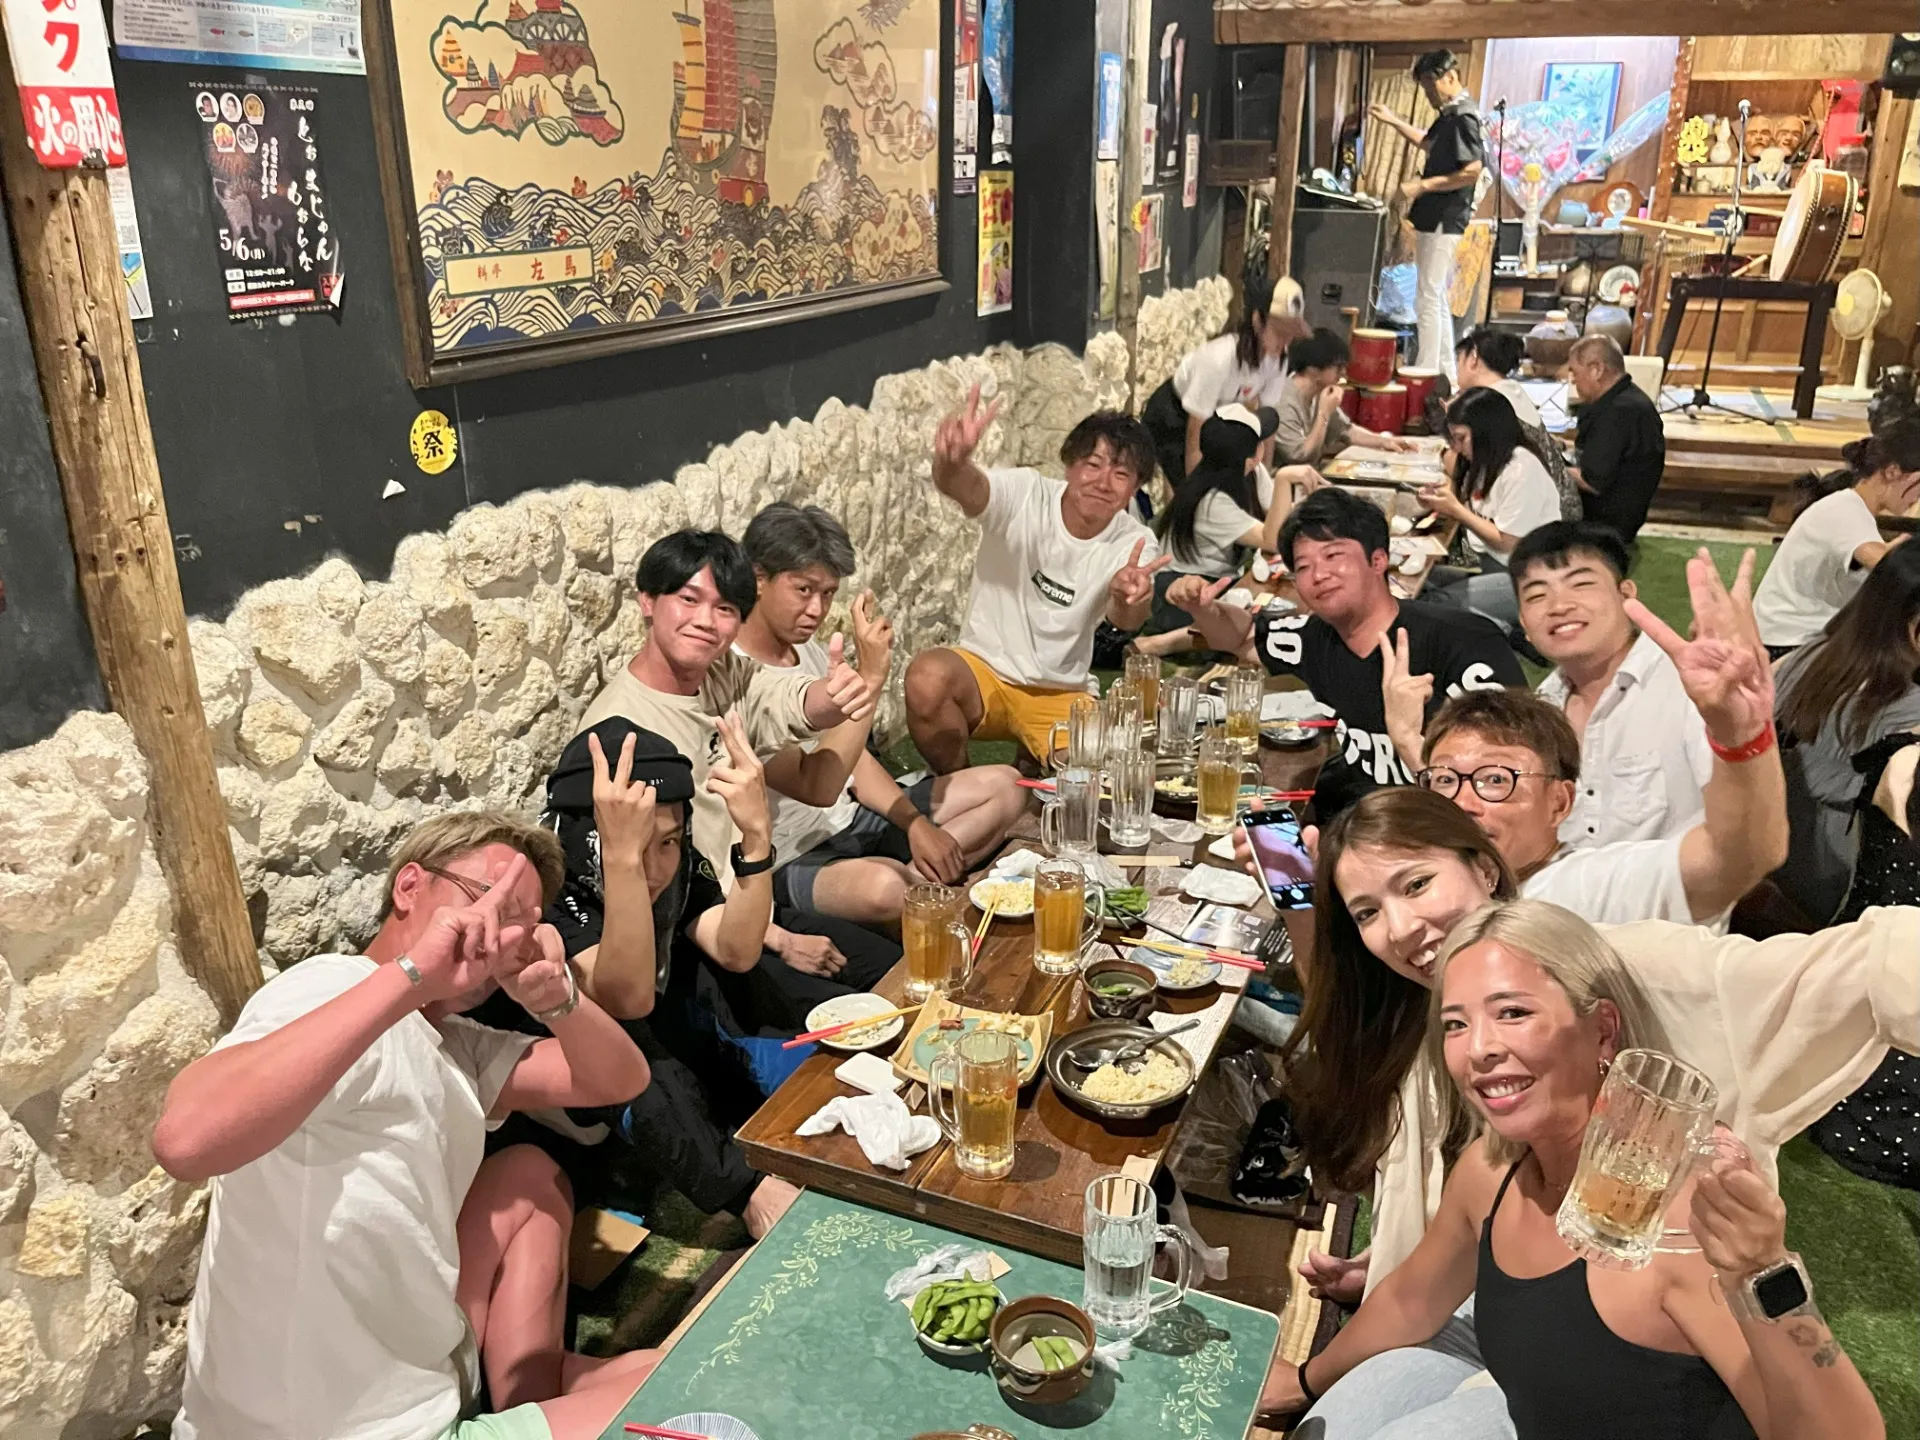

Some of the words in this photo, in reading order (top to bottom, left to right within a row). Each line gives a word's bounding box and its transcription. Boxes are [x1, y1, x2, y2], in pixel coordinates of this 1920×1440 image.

[32, 93, 124, 164] 火の用心
[422, 430, 445, 460] 祭
[1036, 573, 1073, 603] Supreme
